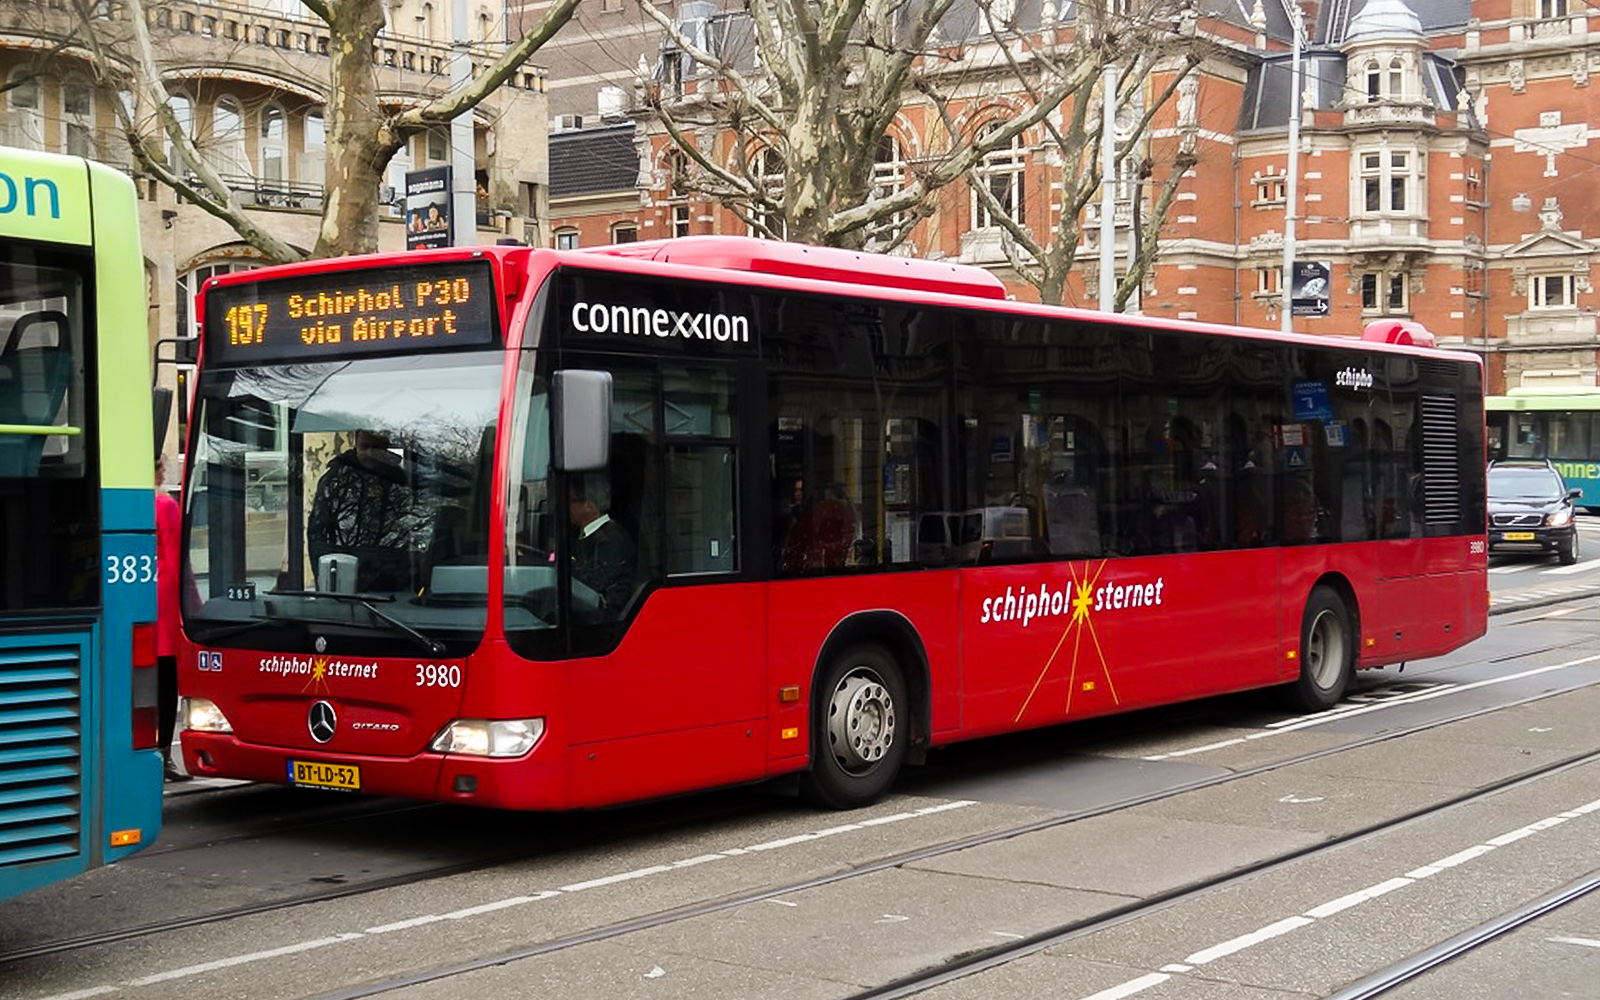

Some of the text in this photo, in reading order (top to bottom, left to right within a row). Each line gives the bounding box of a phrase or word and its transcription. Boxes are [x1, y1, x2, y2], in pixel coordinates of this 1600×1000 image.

[287, 278, 470, 319] Schiphol P30
[224, 303, 268, 345] 197
[301, 309, 457, 345] via Airport
[571, 302, 749, 342] connexxion
[980, 577, 1165, 627] schiphol sternet
[259, 656, 379, 679] schiphol sternet
[415, 663, 461, 688] 3980
[297, 764, 355, 785] BT-LD-52
